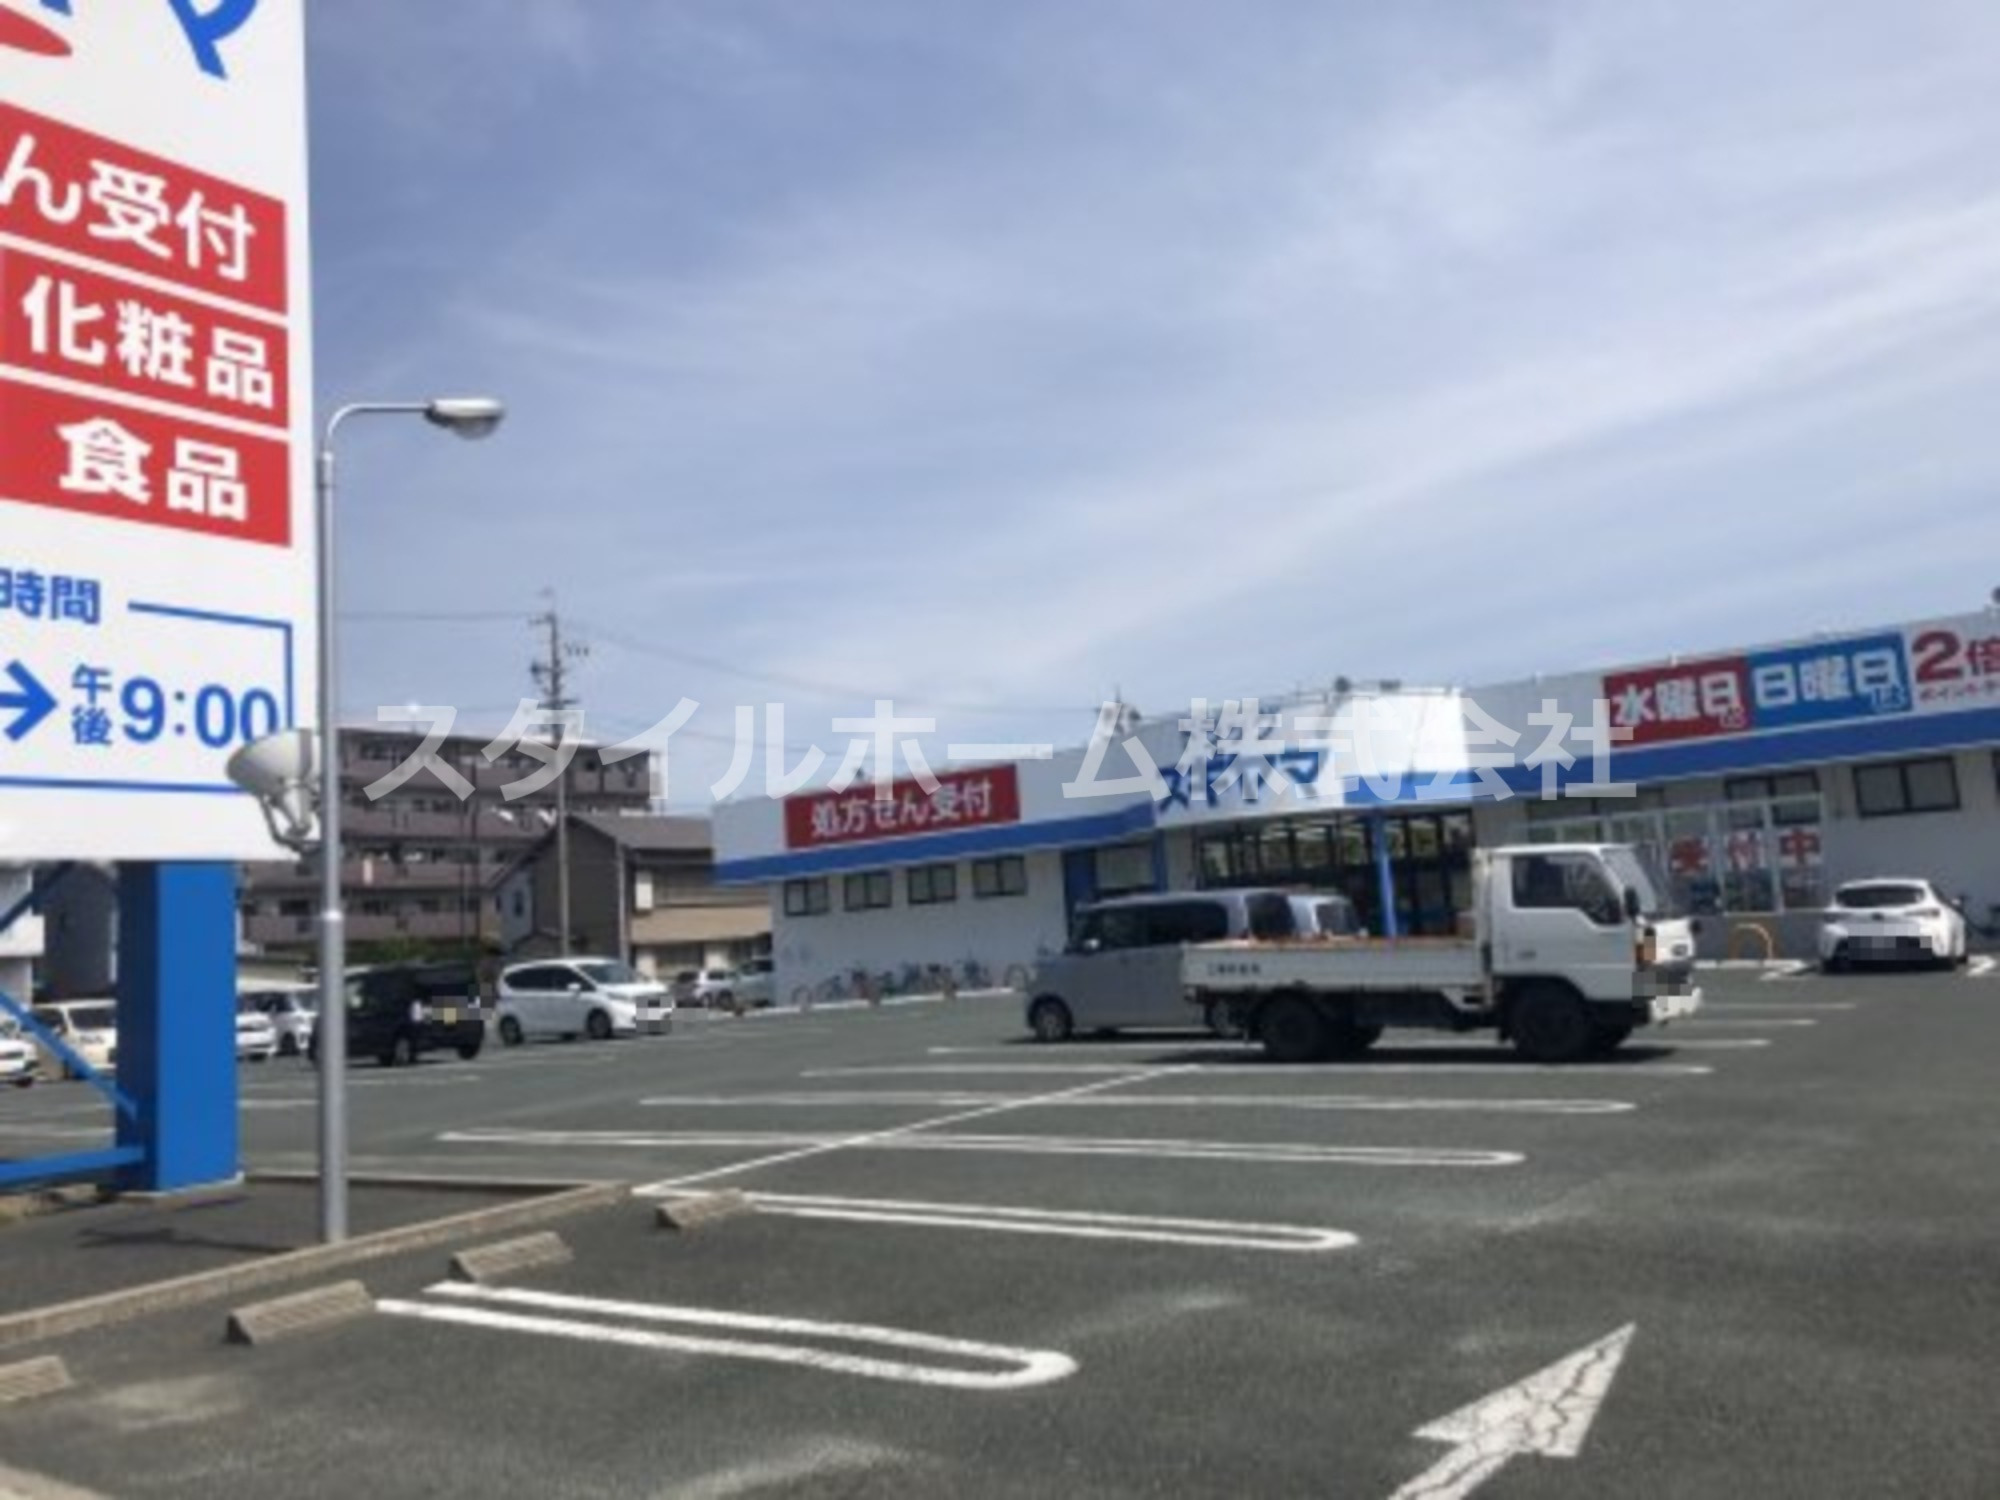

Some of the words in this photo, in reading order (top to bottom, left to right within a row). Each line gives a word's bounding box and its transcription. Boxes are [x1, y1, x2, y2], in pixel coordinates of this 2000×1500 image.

[0, 133, 255, 281] ん受付
[22, 275, 274, 410] 化粧品
[56, 416, 248, 521] 食品
[71, 663, 113, 747] 午後
[119, 676, 279, 748] 9:00
[1612, 670, 1742, 727] 水曜日
[1753, 647, 1901, 708] 日曜日
[811, 776, 993, 838] 処方せん受付
